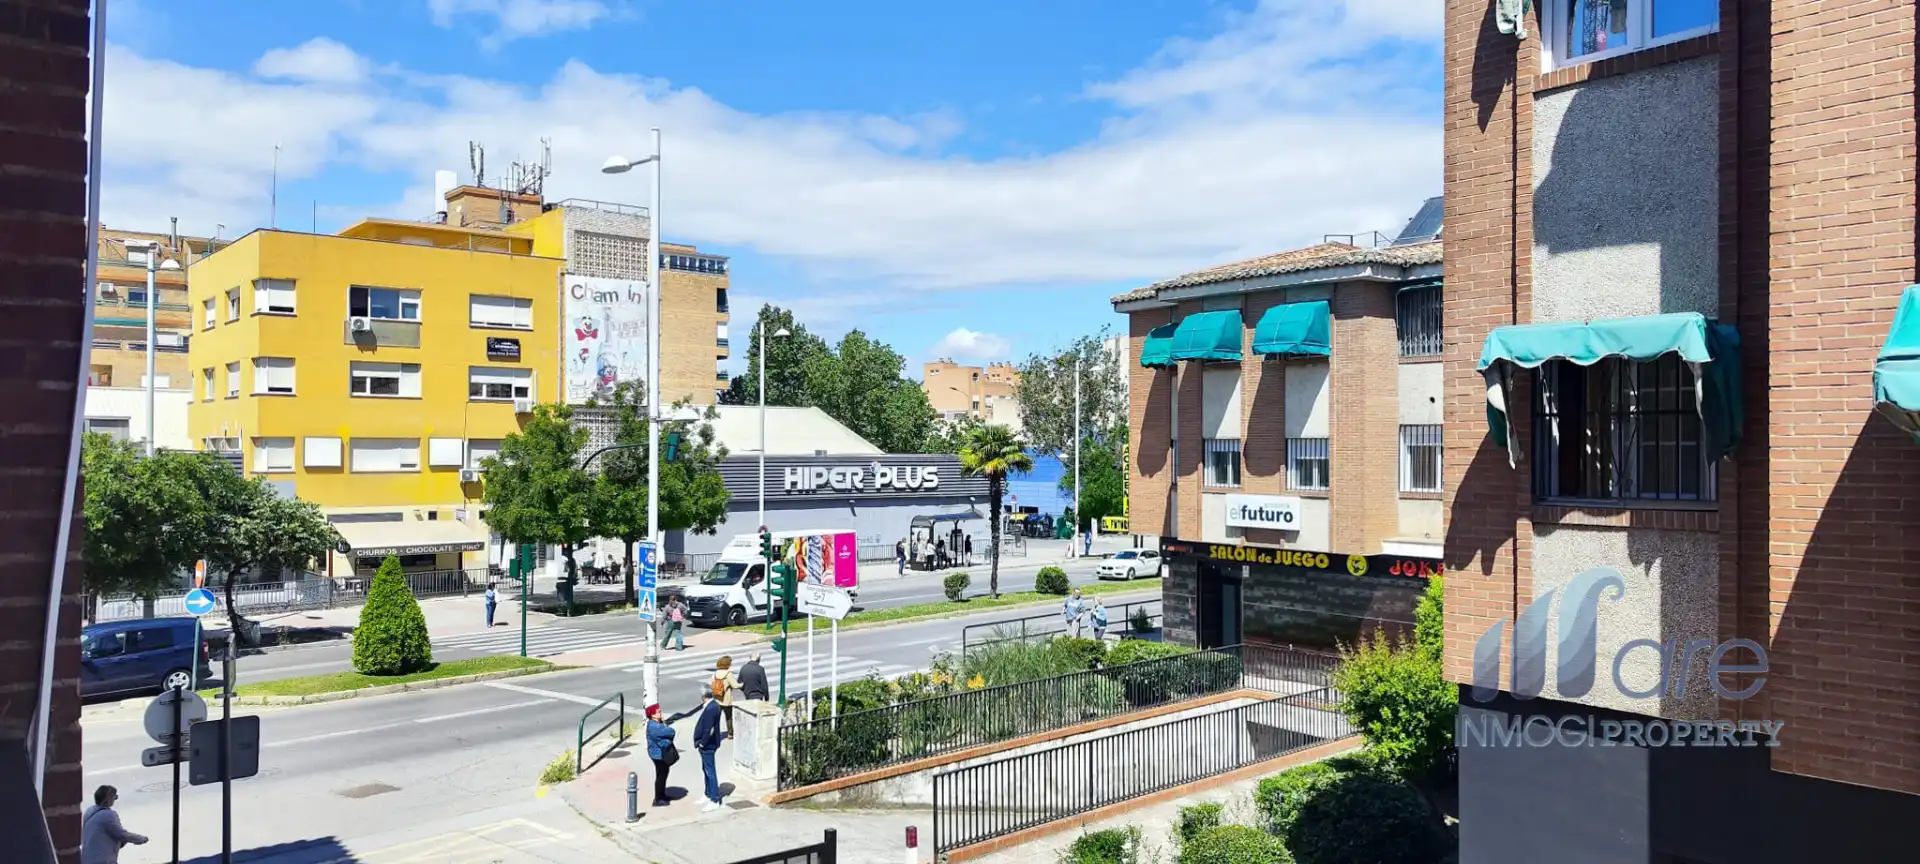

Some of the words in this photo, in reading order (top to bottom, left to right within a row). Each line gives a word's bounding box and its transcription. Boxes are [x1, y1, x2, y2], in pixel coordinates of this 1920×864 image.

[784, 467, 864, 491] HIPER
[874, 466, 938, 489] PLUS
[357, 548, 398, 557] CHURROS
[406, 545, 453, 554] CHOCOLATE
[1258, 553, 1272, 563] de
[1274, 551, 1330, 568] JUEGO
